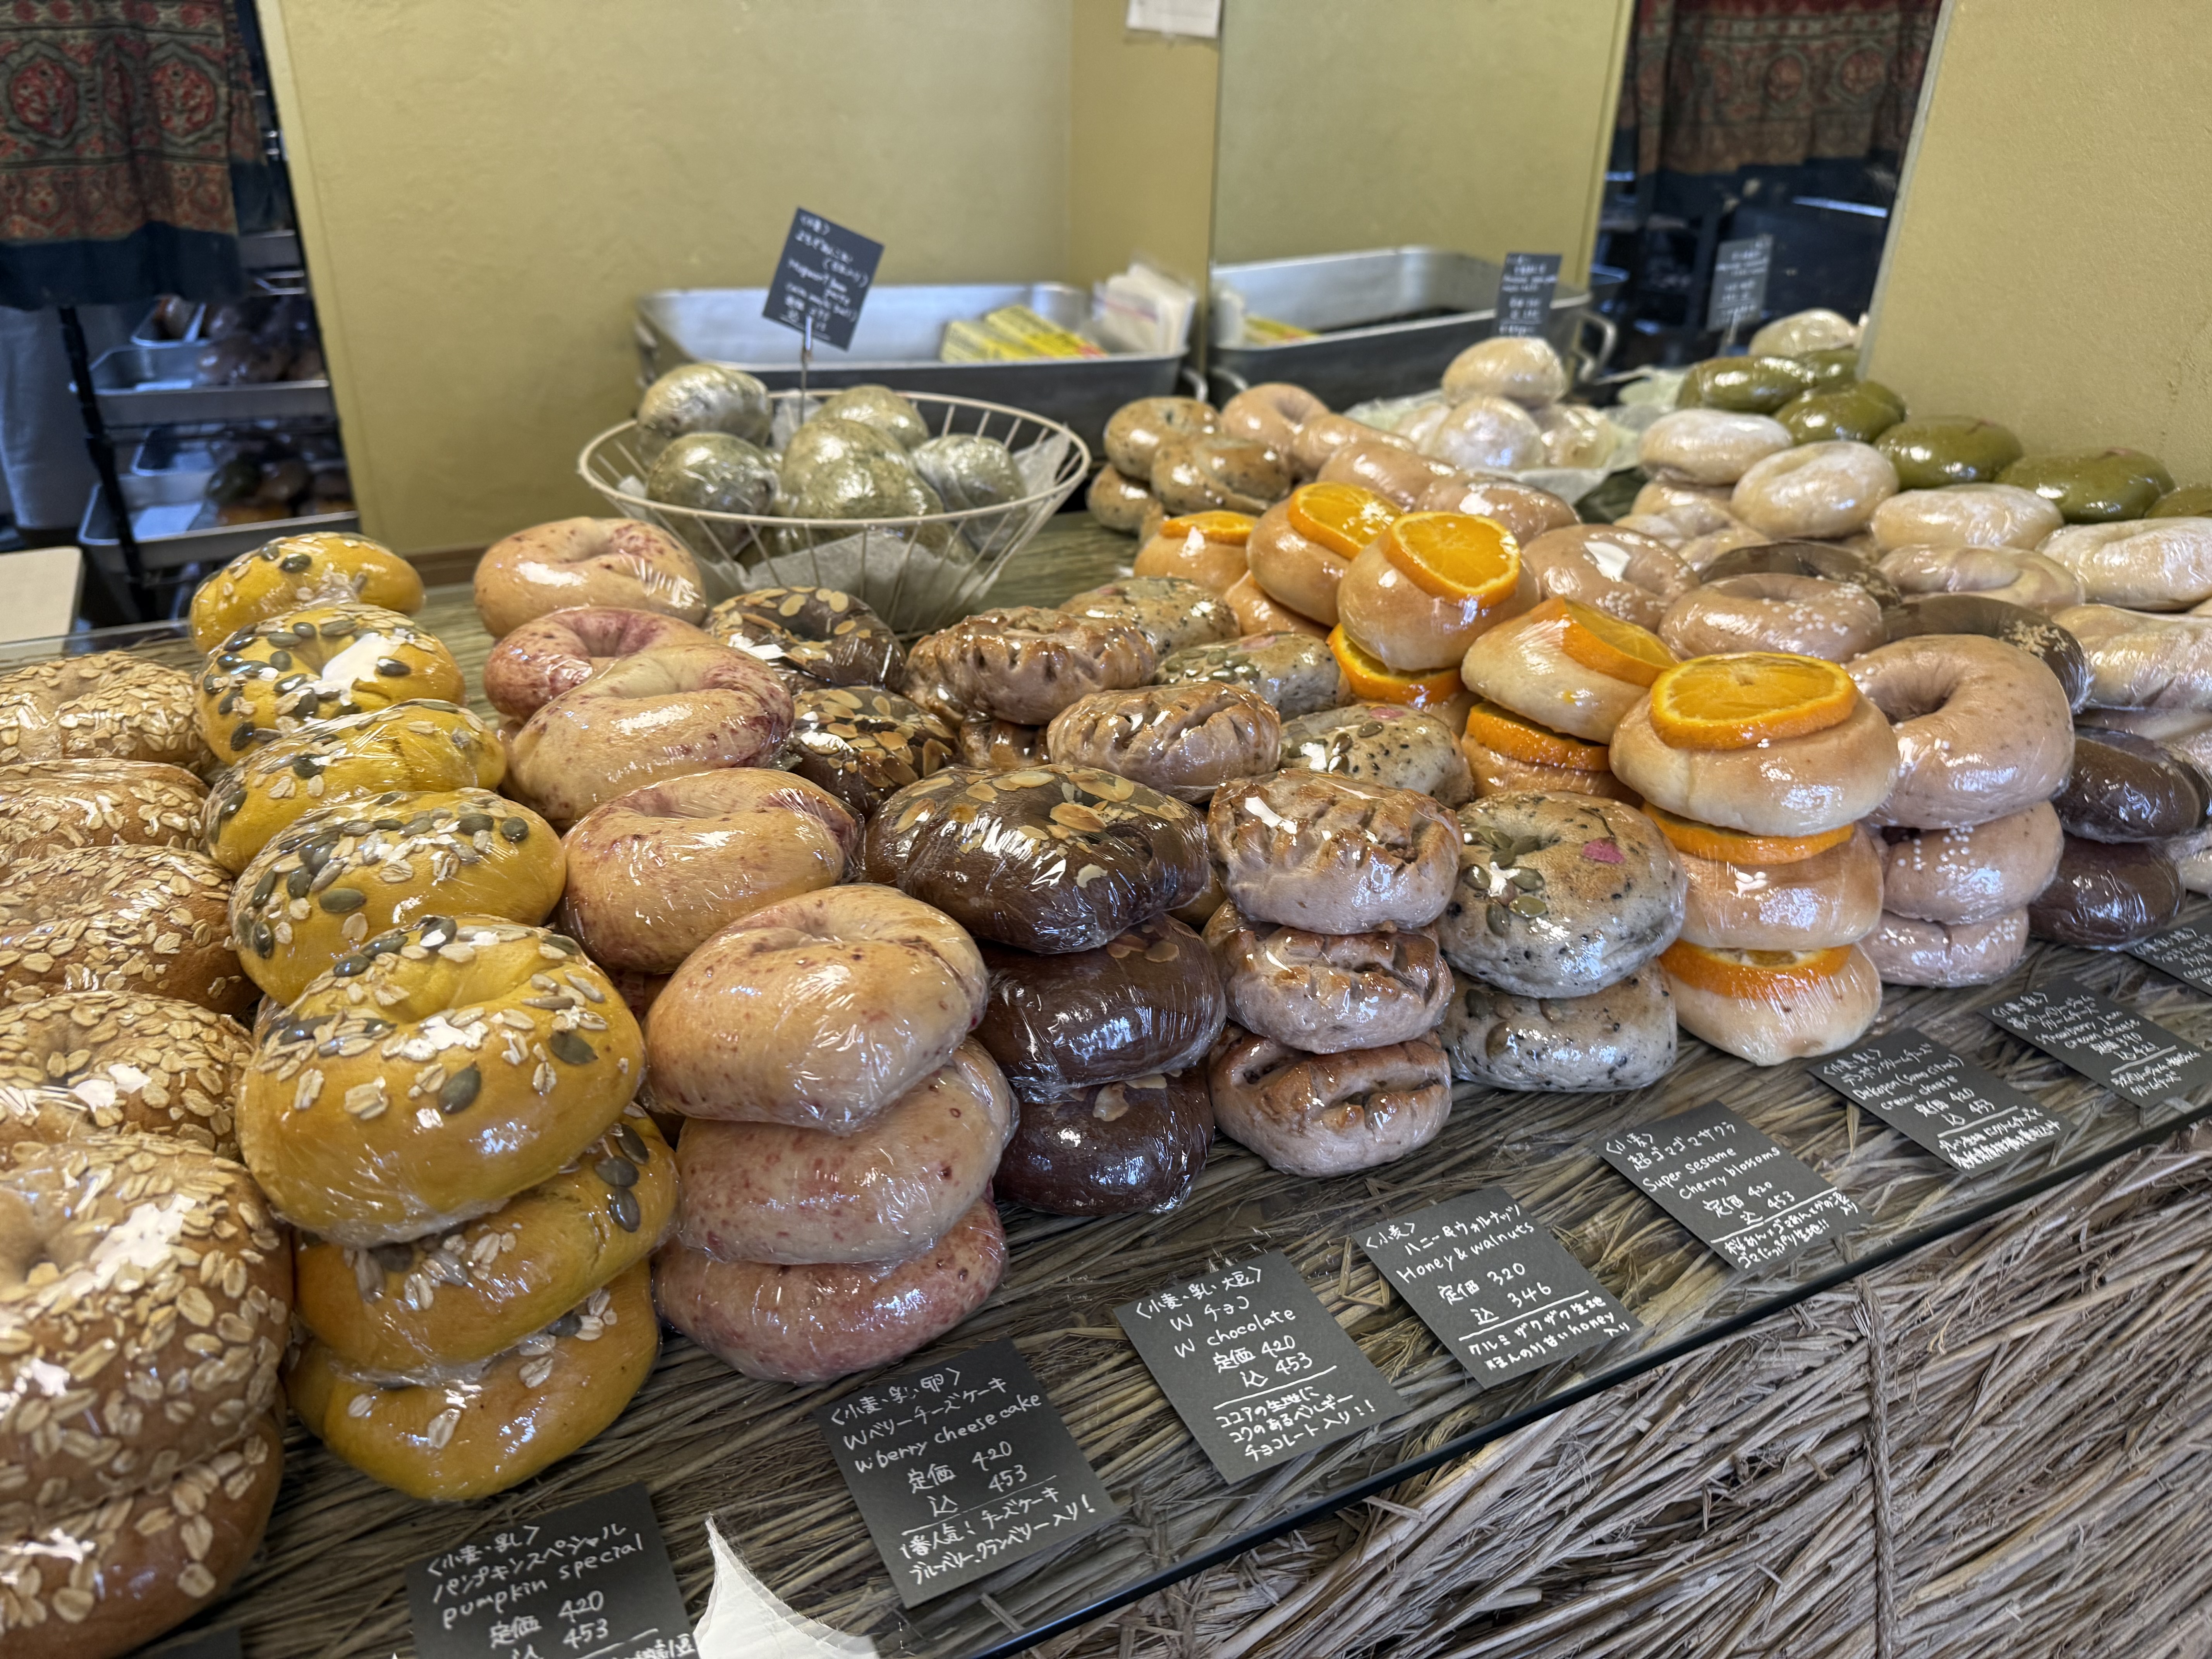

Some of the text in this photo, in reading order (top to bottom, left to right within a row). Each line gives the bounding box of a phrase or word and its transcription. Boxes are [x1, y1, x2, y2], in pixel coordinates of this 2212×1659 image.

[1643, 1148, 1736, 1192] Super sesame
[1728, 1147, 1780, 1177] blossoms
[1748, 1182, 1772, 1196] 420
[1767, 1191, 1795, 1209] 453
[1396, 1223, 1534, 1283] Honey & walnuts
[1437, 1263, 1525, 1305] 定価 320
[1507, 1283, 1551, 1308] 346
[1170, 1296, 1249, 1331] W チョコ
[1568, 1312, 1614, 1335] honey
[1174, 1310, 1296, 1358] W chocolate
[1213, 1335, 1295, 1373] 定価 420
[1240, 1353, 1312, 1388] 込 453
[876, 1441, 927, 1468] berry
[1245, 1425, 1317, 1462] チョコレート
[907, 1442, 1012, 1494] 定価 420
[927, 1464, 1027, 1517] 込 453
[982, 1487, 1058, 1530] チーズケーキ
[443, 1533, 642, 1629] pumpkin special
[490, 1591, 604, 1649] 定価 420
[563, 1618, 608, 1649] 453
